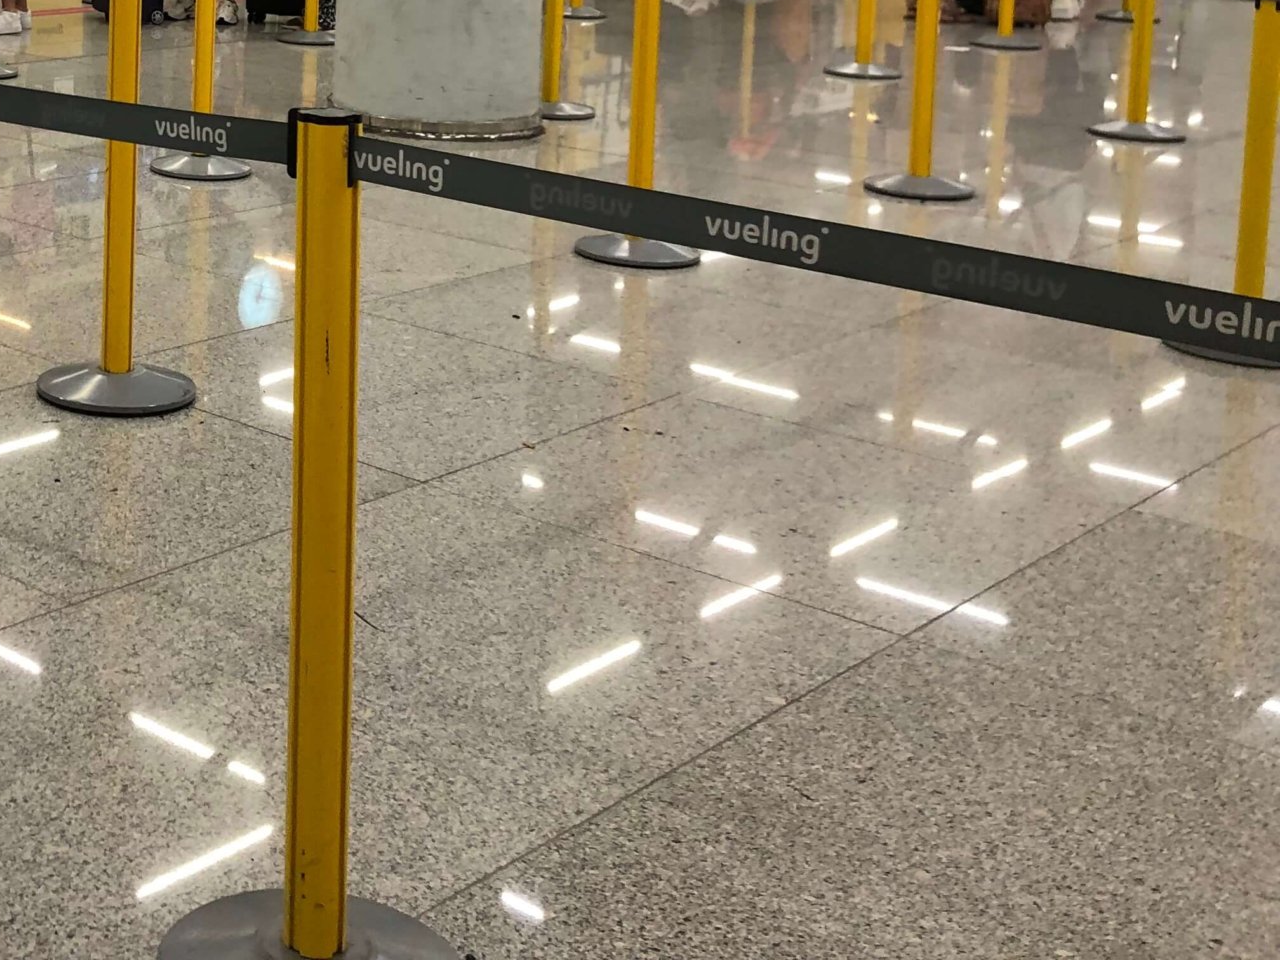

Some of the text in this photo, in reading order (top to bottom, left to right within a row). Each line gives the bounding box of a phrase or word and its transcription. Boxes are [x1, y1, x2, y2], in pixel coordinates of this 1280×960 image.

[155, 115, 231, 151] vueling
[354, 148, 450, 192] vueling
[705, 215, 830, 266] vueling
